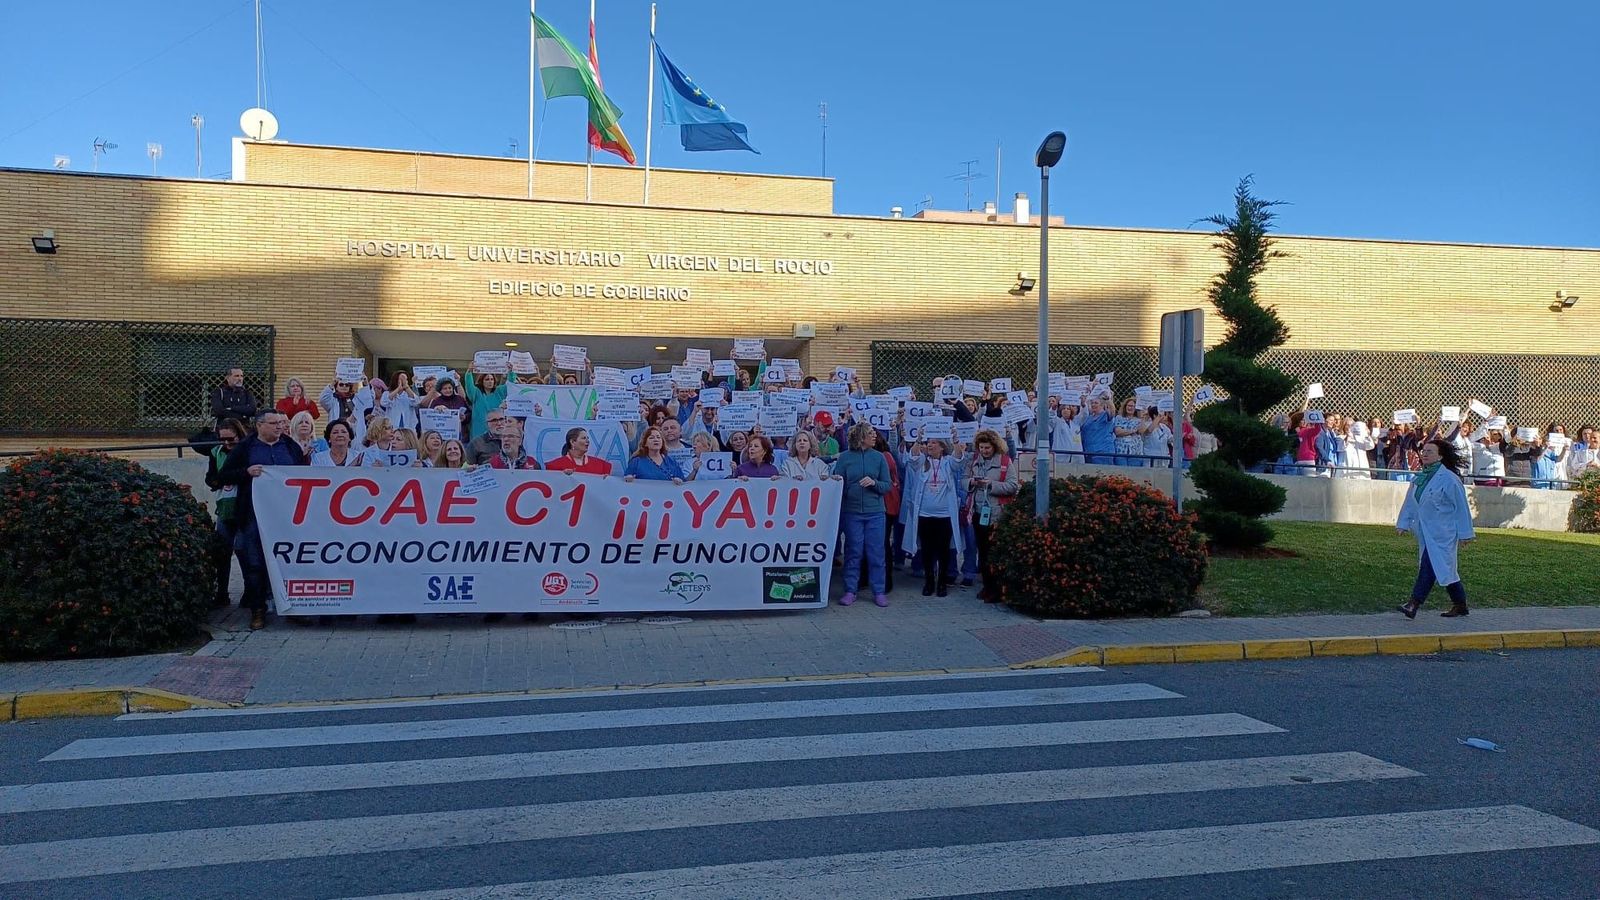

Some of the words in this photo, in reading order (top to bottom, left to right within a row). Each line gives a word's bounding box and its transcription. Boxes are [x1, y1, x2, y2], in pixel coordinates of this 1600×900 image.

[347, 240, 456, 260] HOSPITAL
[467, 244, 623, 268] UNIVERSITARIO
[647, 253, 719, 271] VIRGEN
[728, 257, 763, 273] DEL
[773, 259, 833, 275] ROCIO
[488, 280, 566, 297] EDIFICIO
[573, 283, 597, 298] DE
[602, 284, 690, 301] GOBIERNO
[630, 373, 644, 386] C1
[767, 370, 780, 380] C1
[837, 371, 848, 381] C1
[995, 382, 1007, 391] C1
[1099, 377, 1109, 385] C1
[941, 385, 955, 396] C1
[1196, 390, 1209, 400] C1
[855, 402, 871, 411] C1
[909, 407, 925, 417] C1
[869, 414, 885, 426] C1
[1308, 413, 1320, 421] C1
[388, 454, 409, 466] C1
[706, 458, 725, 471] C1
[285, 478, 478, 526] TCAE
[505, 481, 586, 527] C1
[272, 540, 591, 565] RECONOCIMIENTO
[600, 543, 644, 564] DE
[652, 542, 827, 564] FUNCIONES
[545, 576, 565, 587] UGT
[292, 583, 339, 593] CCOO
